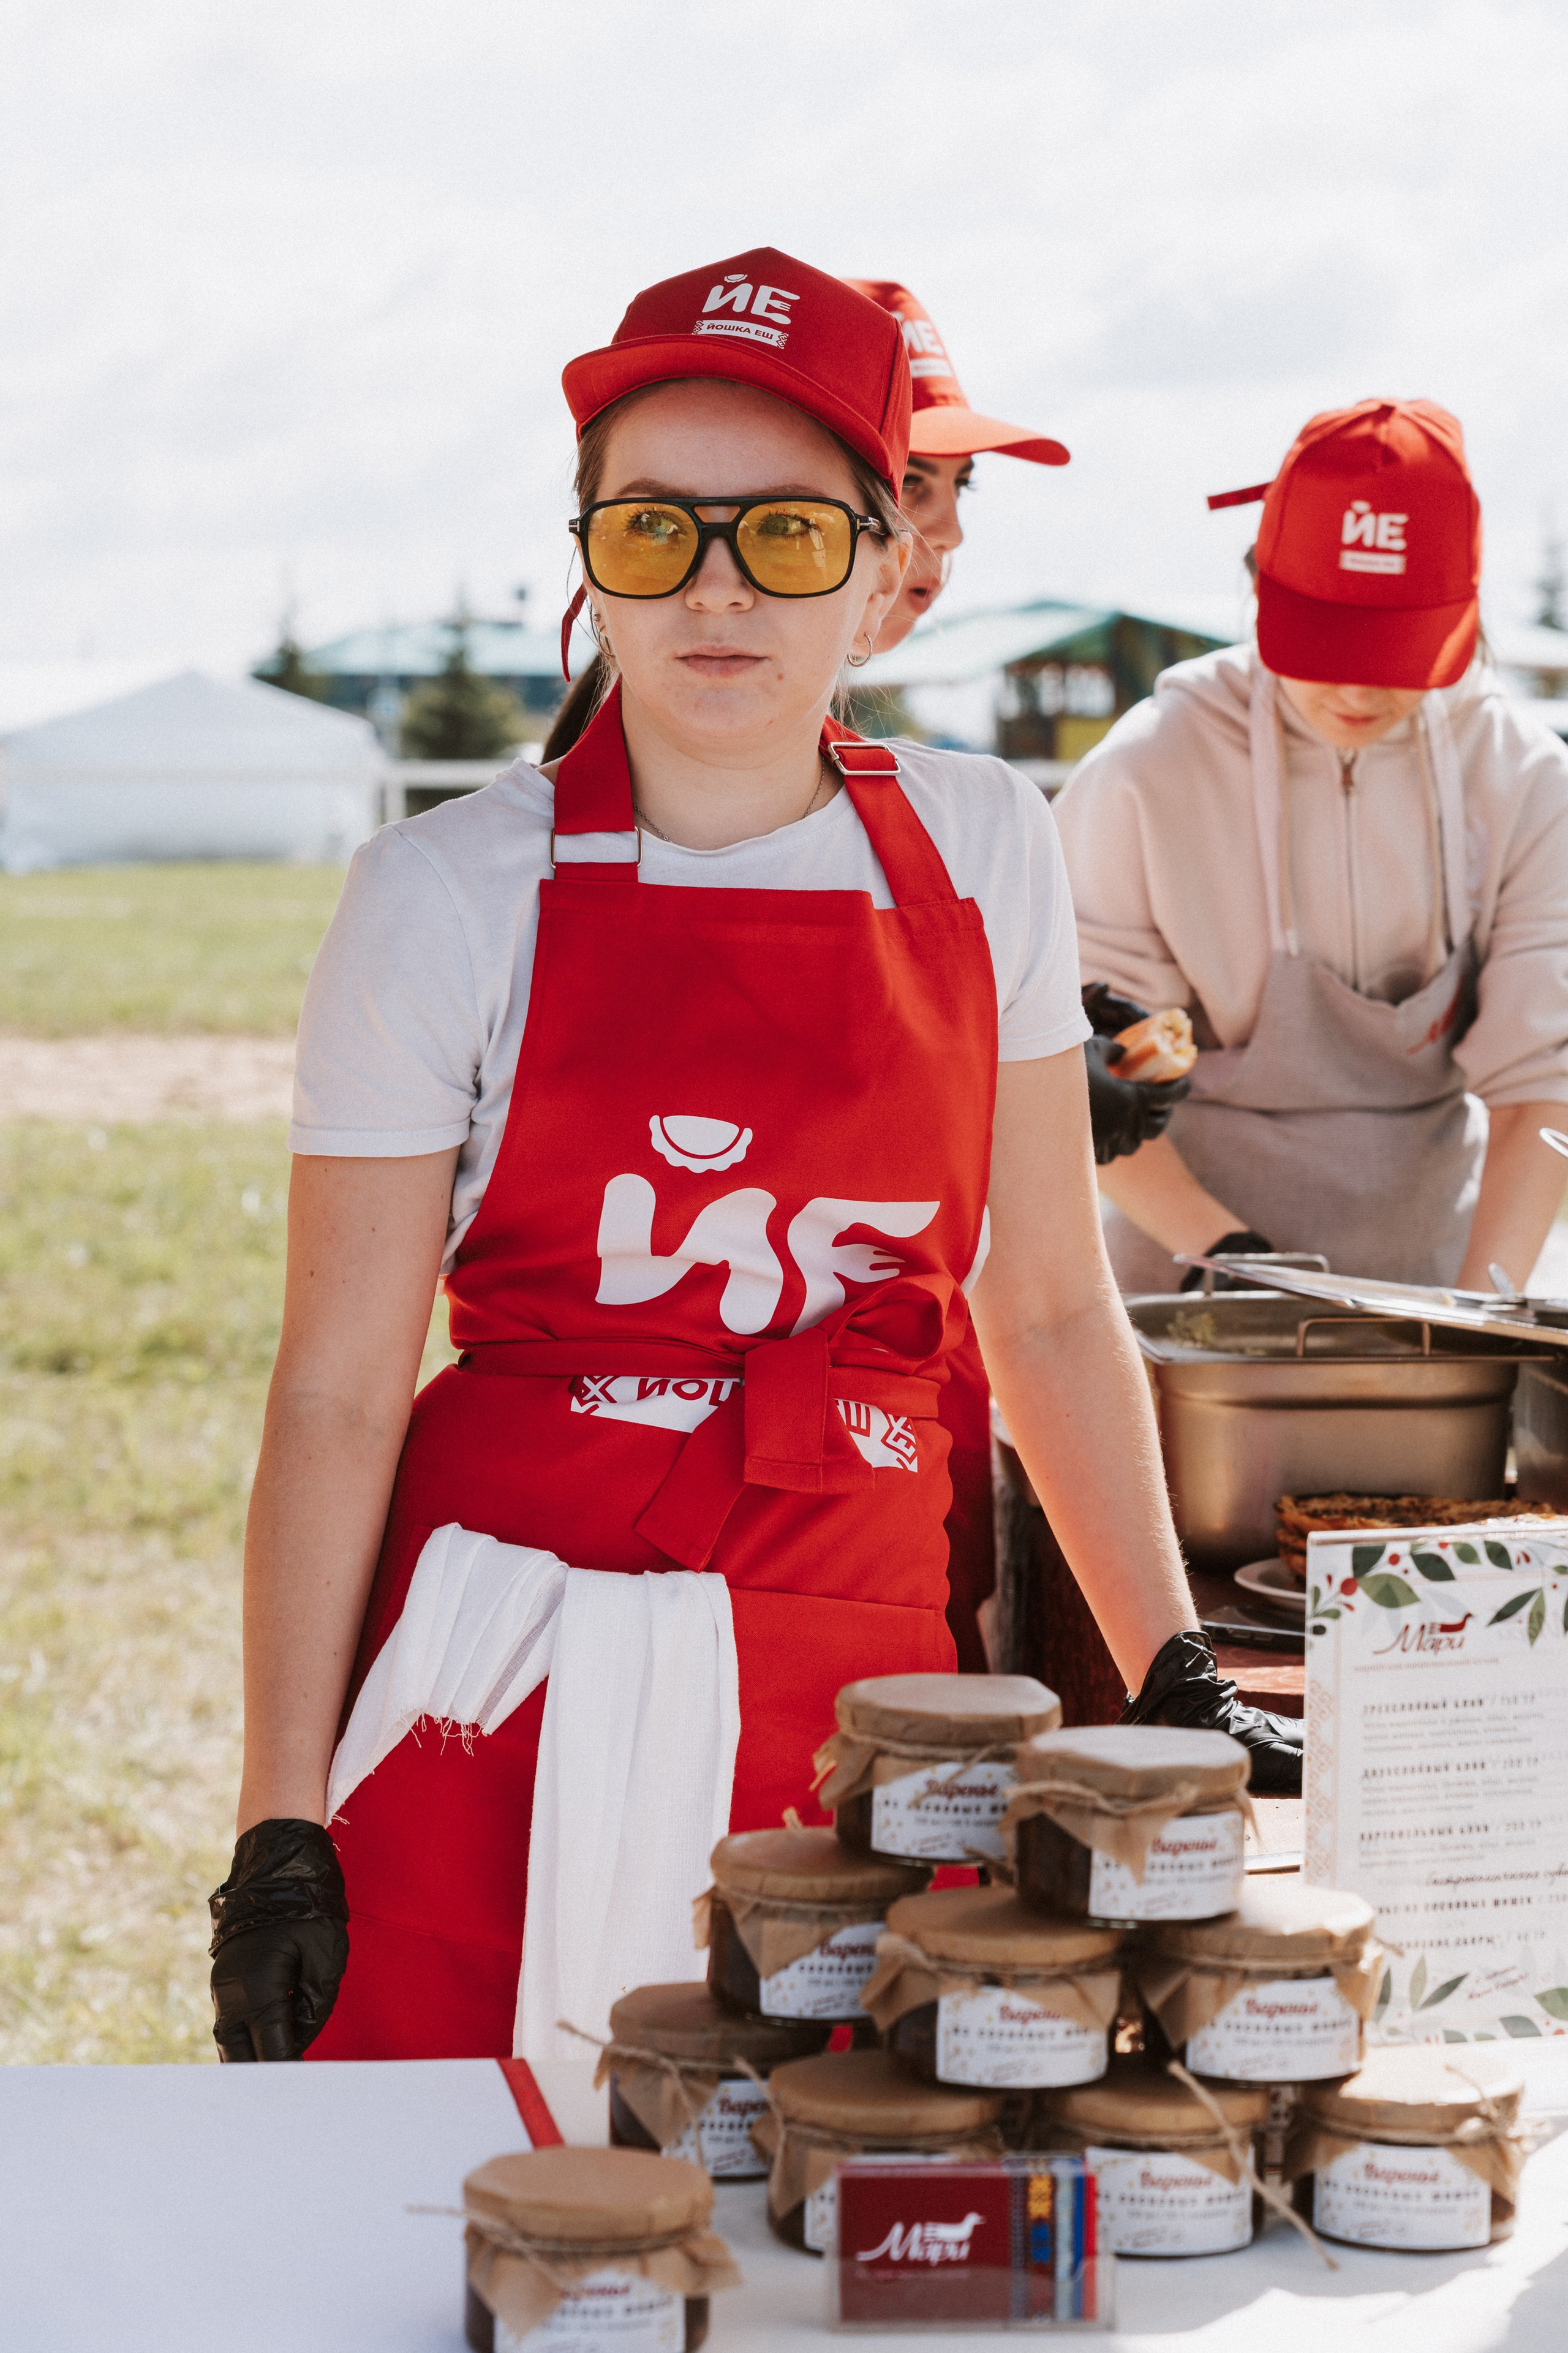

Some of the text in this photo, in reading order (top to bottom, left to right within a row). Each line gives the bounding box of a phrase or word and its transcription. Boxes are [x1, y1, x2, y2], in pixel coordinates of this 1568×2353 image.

[701, 274, 801, 325] ЙЕ
[706, 322, 774, 339] ЙОШКА ЕШ
[1341, 499, 1409, 551] ЙЕ
[1372, 1624, 1466, 1656] Мари
